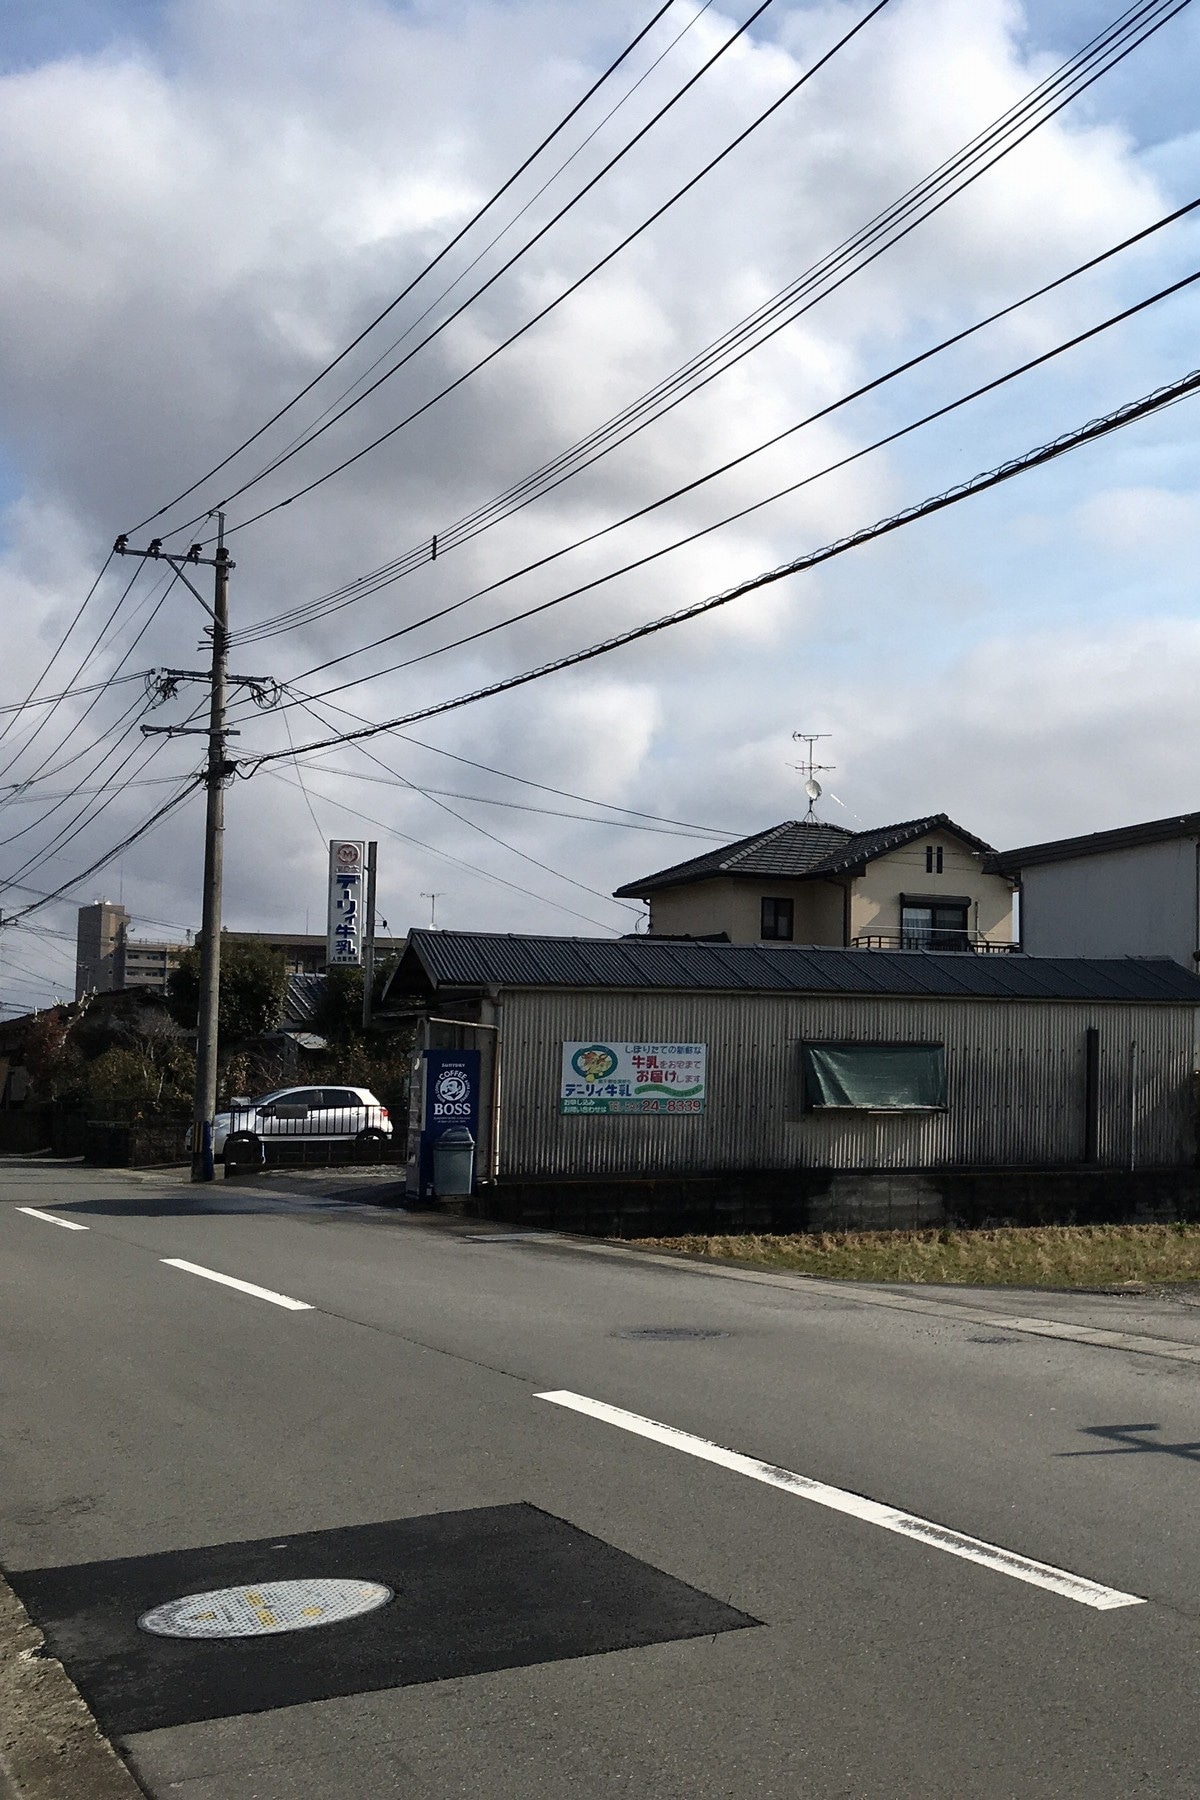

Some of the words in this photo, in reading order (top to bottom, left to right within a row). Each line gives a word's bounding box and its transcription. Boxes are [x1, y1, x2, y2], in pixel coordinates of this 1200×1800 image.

[335, 874, 361, 955] デーリィ牛乳
[439, 1070, 468, 1080] COFFEE
[636, 1070, 701, 1083] お届けします
[565, 1084, 632, 1097] デーリィ牛乳
[433, 1103, 471, 1115] BOSS
